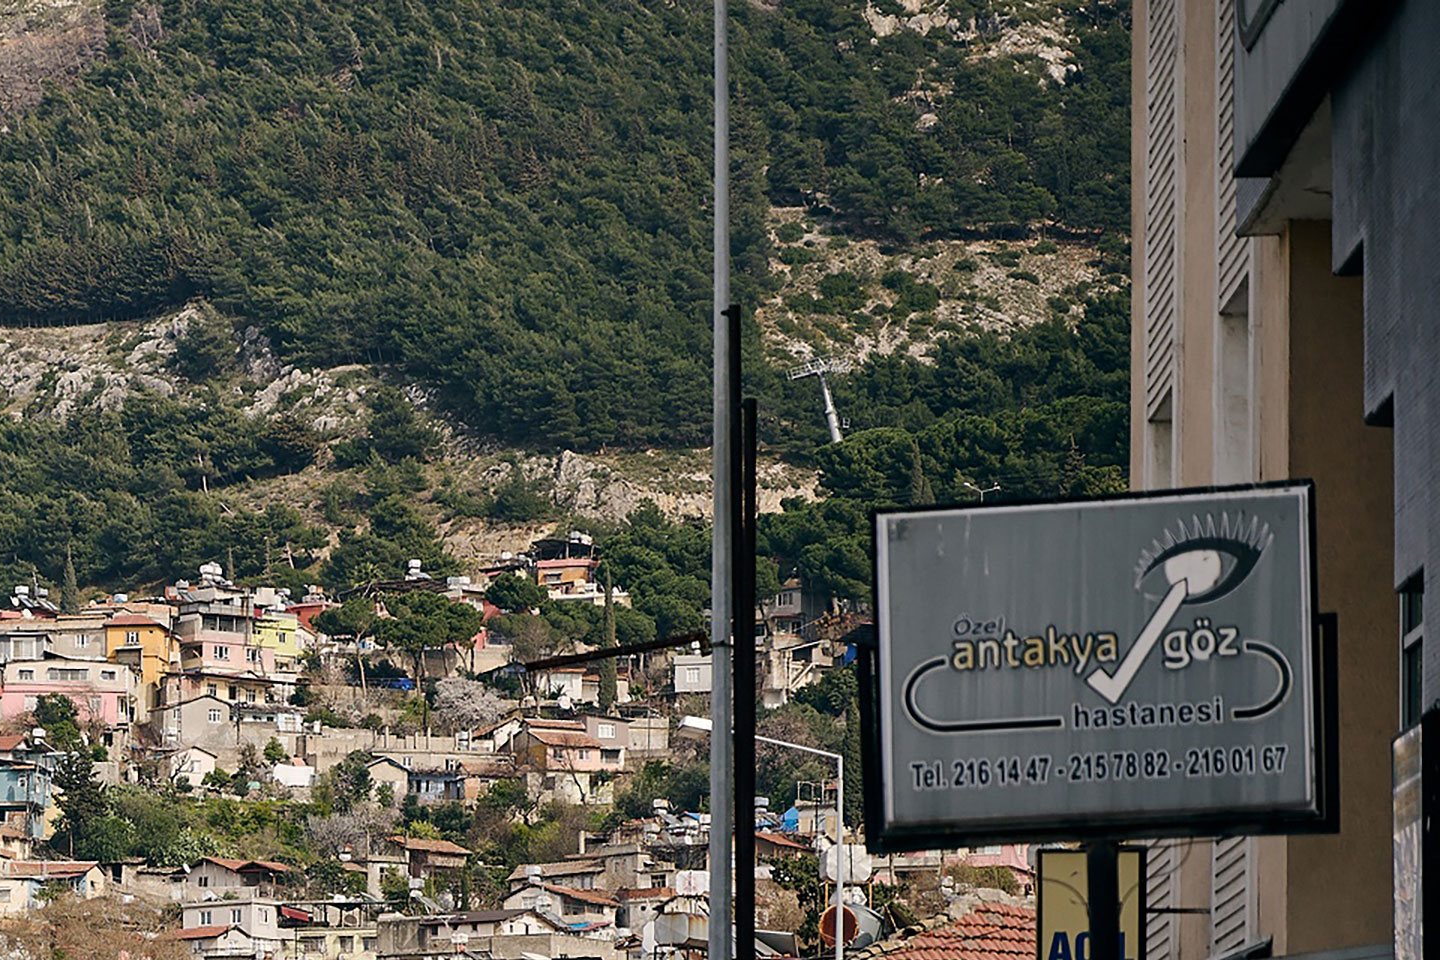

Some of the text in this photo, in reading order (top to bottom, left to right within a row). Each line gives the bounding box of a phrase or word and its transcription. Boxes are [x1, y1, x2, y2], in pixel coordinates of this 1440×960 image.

[953, 614, 1004, 635] Özel
[951, 618, 1240, 674] antakya göz
[1072, 696, 1224, 730] hastanesi
[912, 761, 948, 791] Tel.
[954, 759, 990, 787] 216
[996, 759, 1019, 785] 14
[1020, 757, 1050, 784] 47
[1070, 754, 1106, 781] 215
[1112, 752, 1139, 779] 78
[1144, 750, 1169, 778] 82
[1187, 748, 1224, 776] 216
[1231, 747, 1256, 774] 01
[1262, 745, 1288, 772] 67
